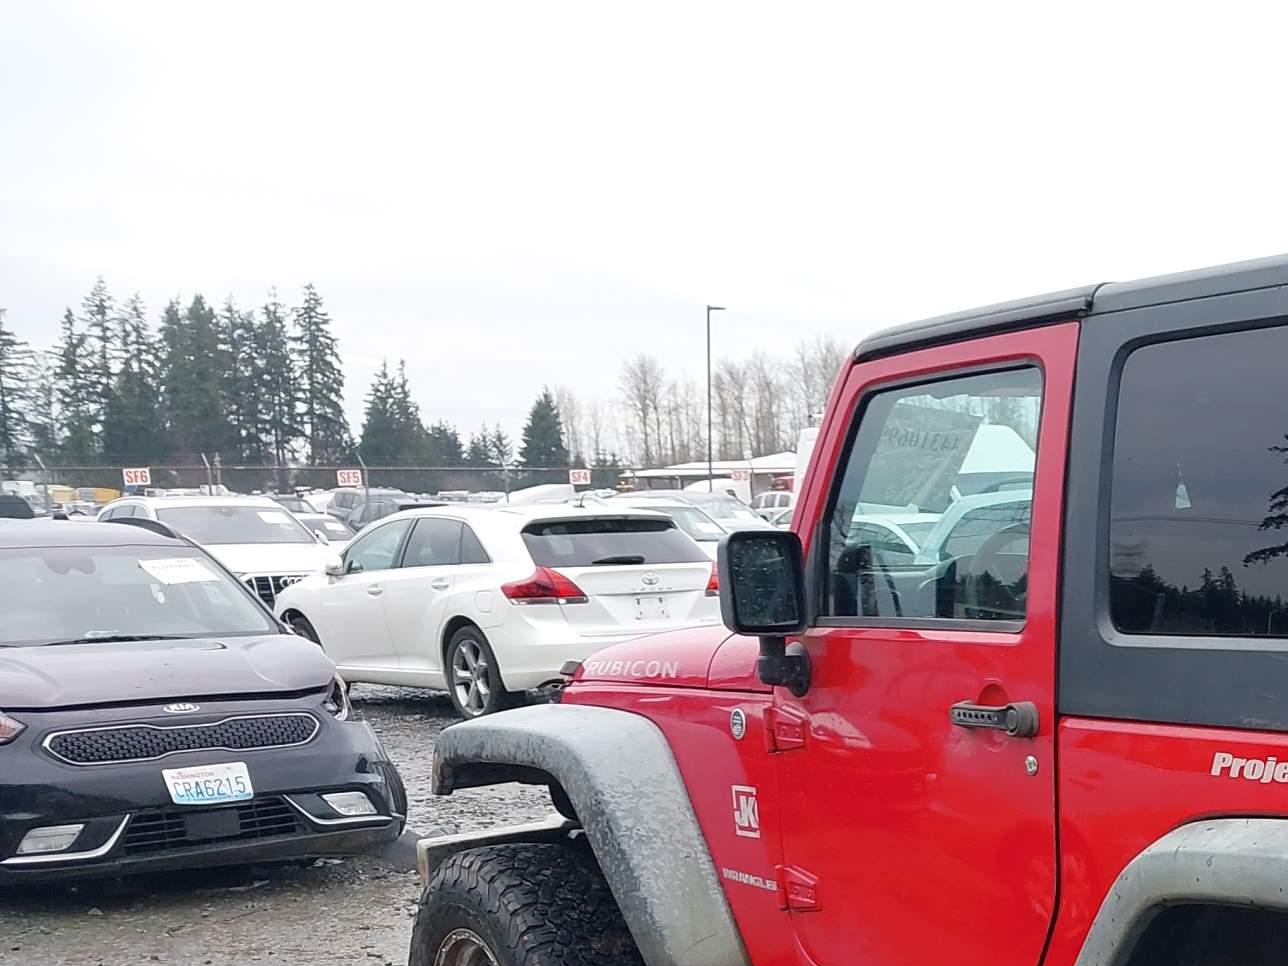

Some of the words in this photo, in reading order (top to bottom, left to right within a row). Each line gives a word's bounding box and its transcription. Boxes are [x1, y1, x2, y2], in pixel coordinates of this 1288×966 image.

[125, 471, 148, 483] SF6
[339, 472, 360, 484] SF5
[571, 471, 588, 482] SF4
[585, 660, 679, 678] RUBICON
[173, 775, 246, 798] CRA6215
